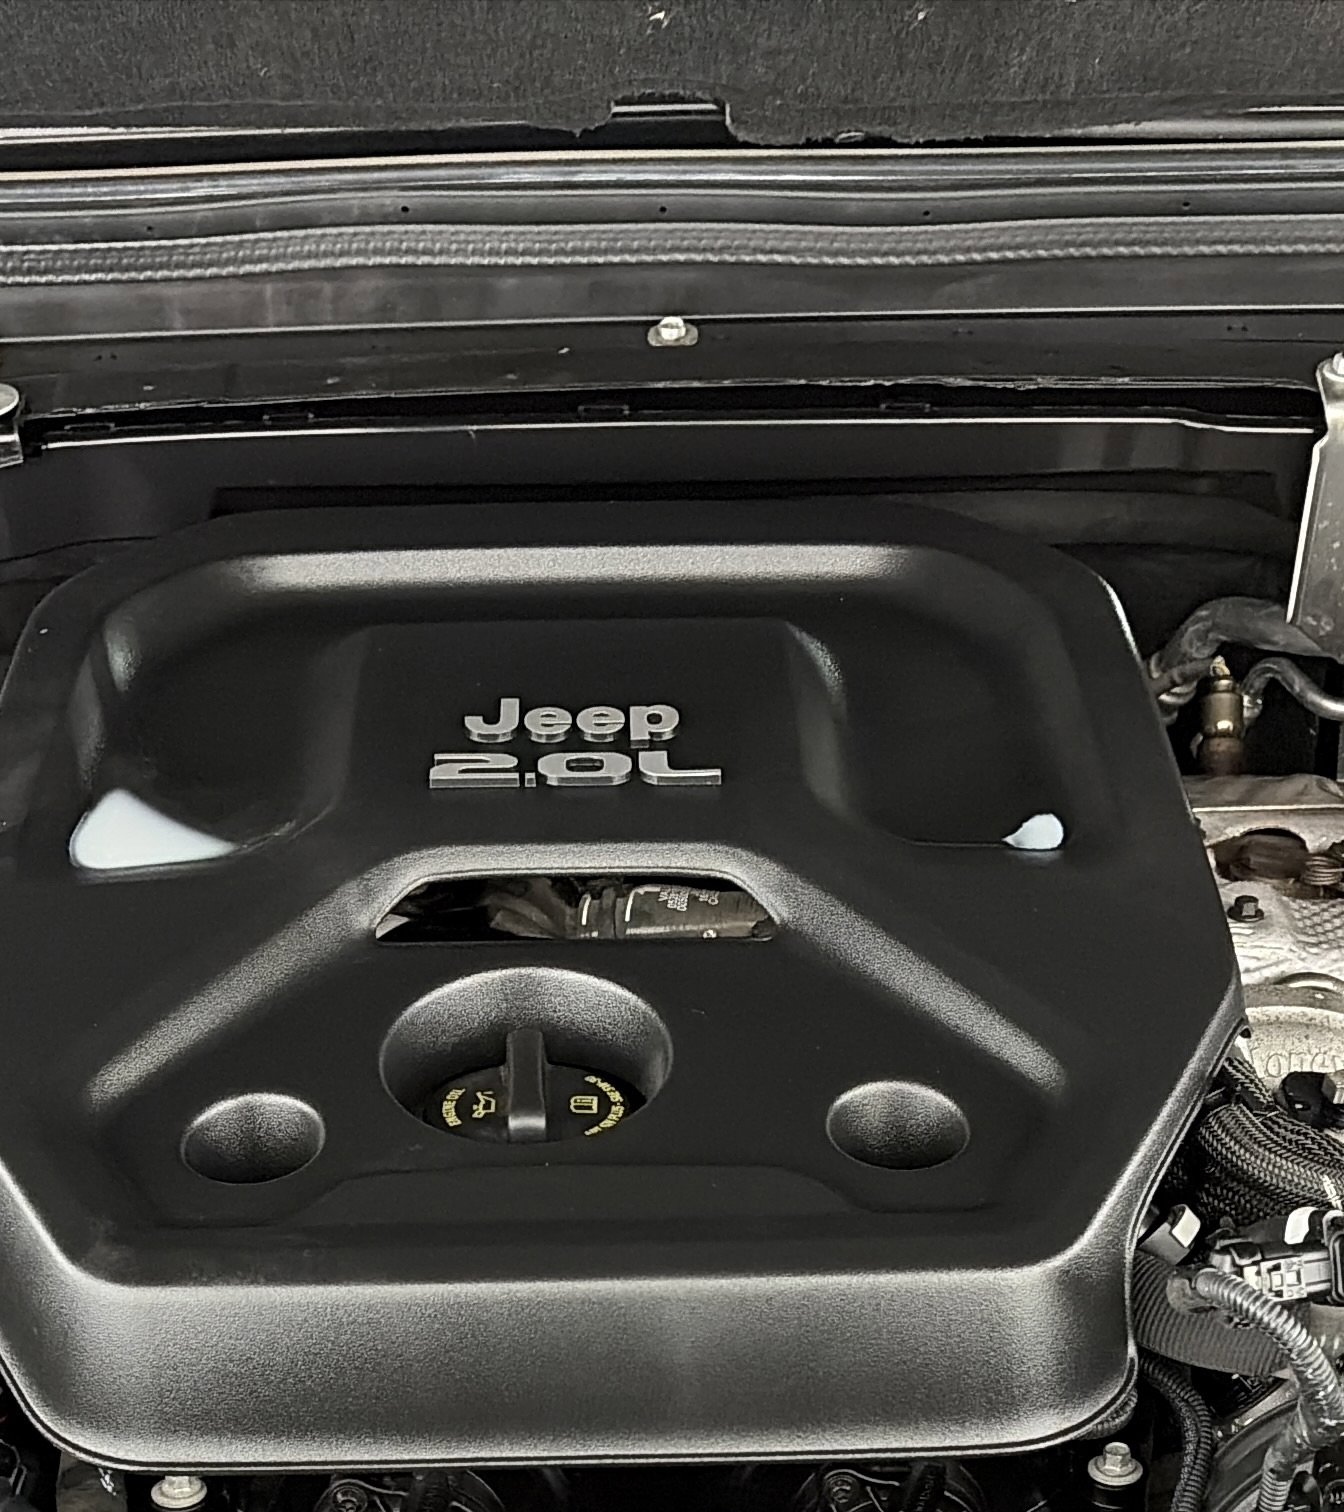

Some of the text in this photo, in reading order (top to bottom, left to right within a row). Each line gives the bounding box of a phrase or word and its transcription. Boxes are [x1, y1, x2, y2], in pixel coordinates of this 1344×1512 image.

[464, 697, 681, 748] Jeep
[428, 751, 723, 789] 2.0L
[442, 1088, 466, 1127] ENGINE OIL
